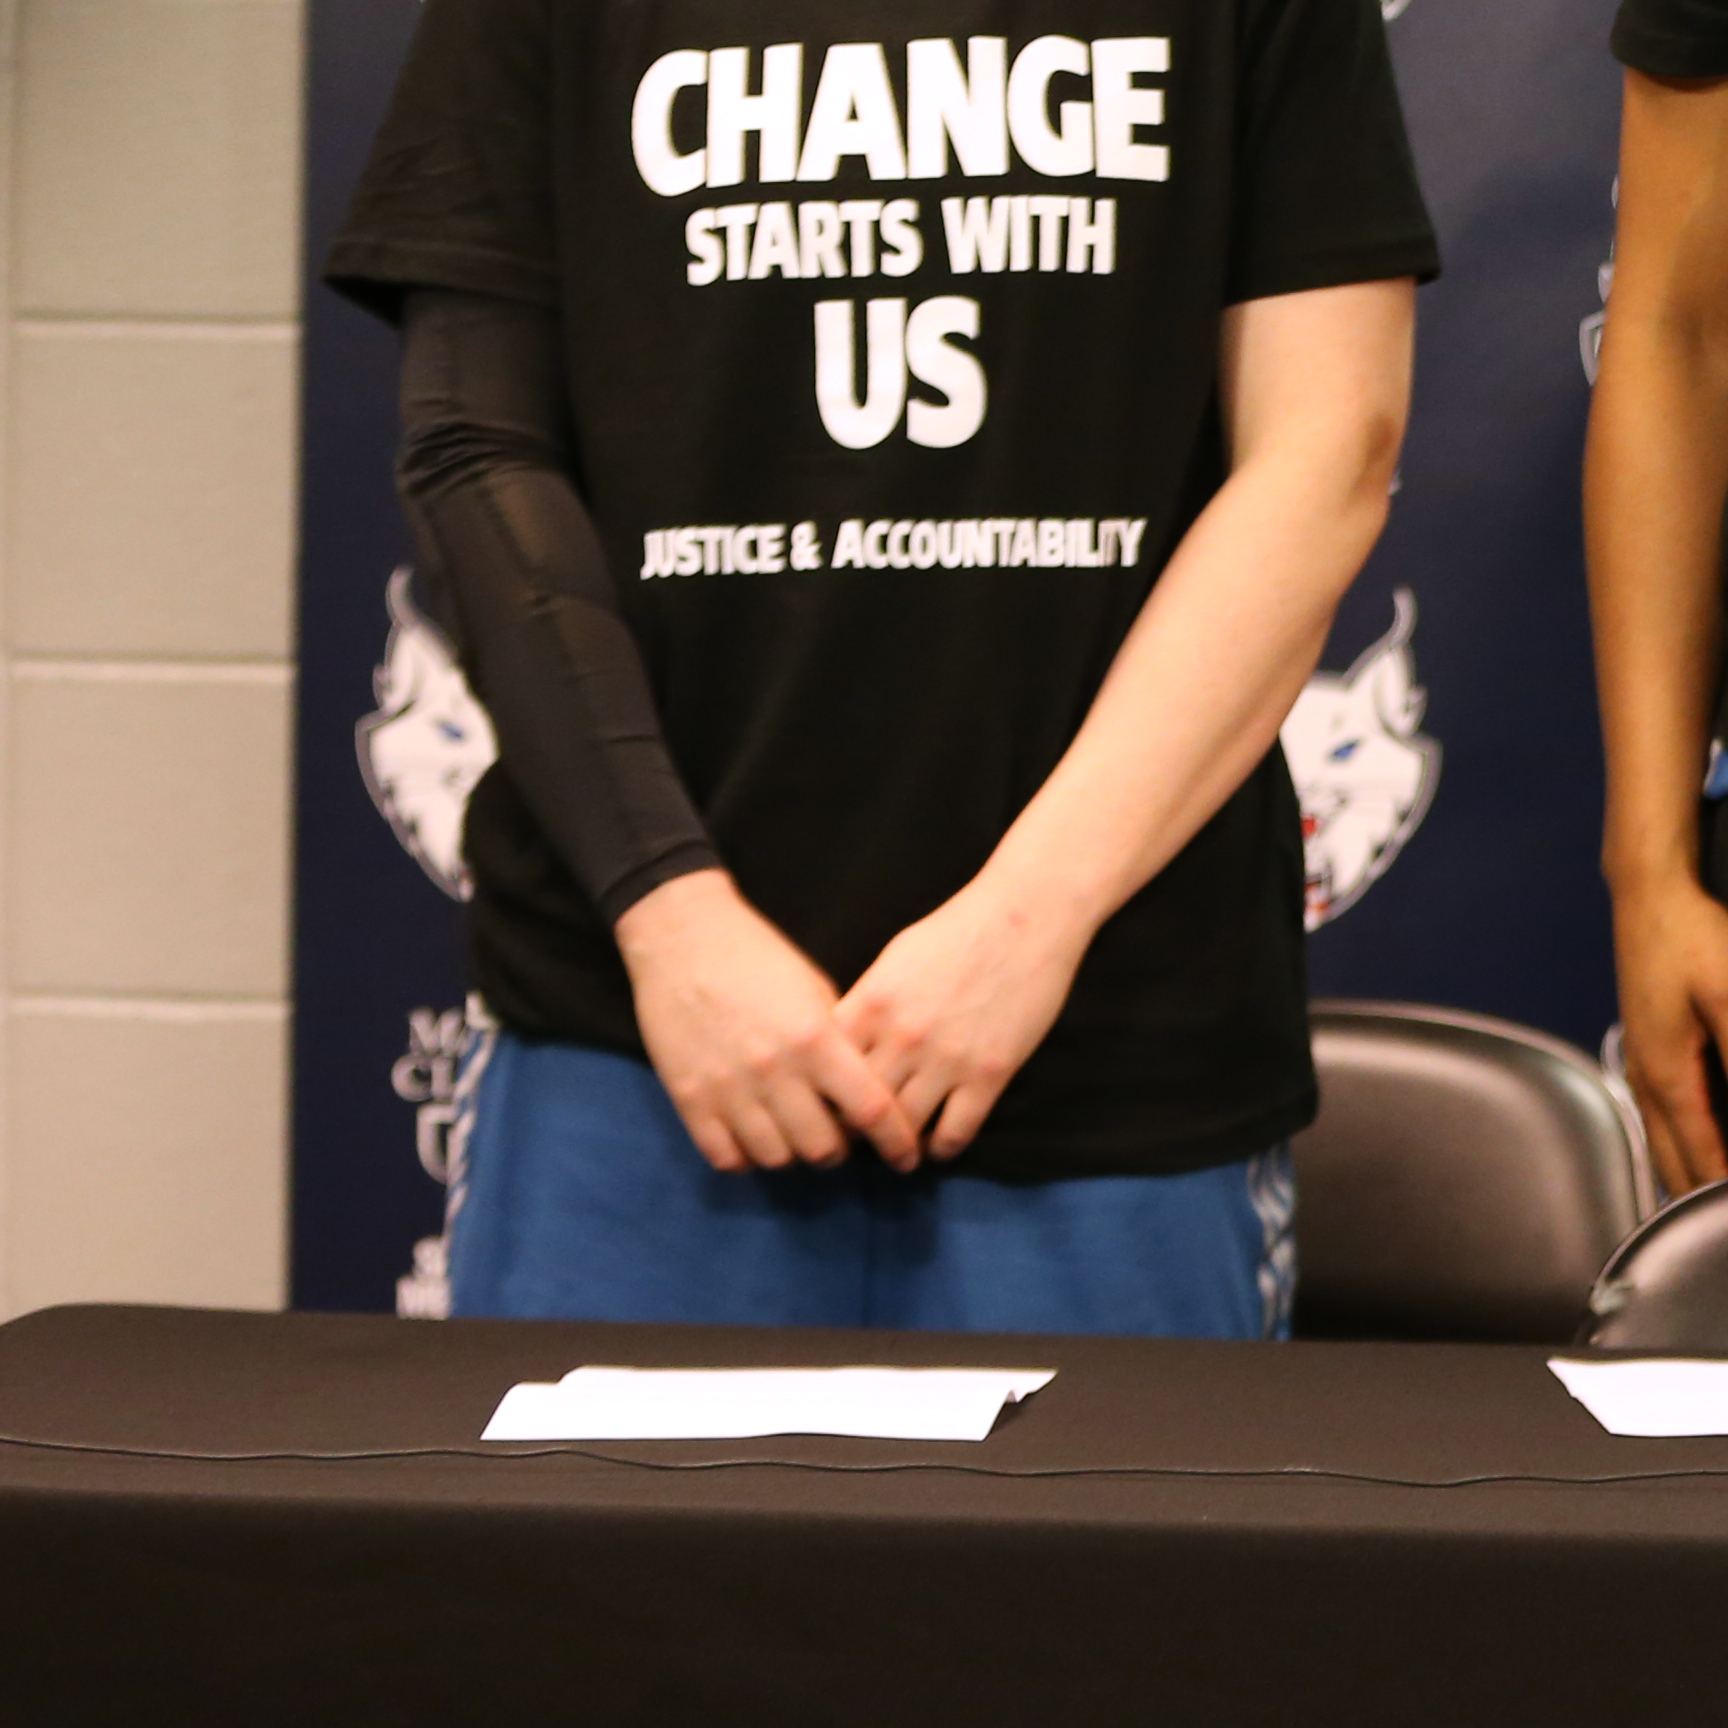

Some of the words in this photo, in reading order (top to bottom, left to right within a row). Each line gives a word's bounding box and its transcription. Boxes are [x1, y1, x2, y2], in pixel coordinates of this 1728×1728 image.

[631, 35, 1171, 197] CHANGE
[685, 198, 924, 286] STARTS
[941, 194, 1117, 275] WITH
[814, 295, 988, 450] US
[640, 523, 788, 580] JUSTICE
[790, 520, 823, 572] &
[831, 517, 1148, 570] ACCOUNTABILITY
